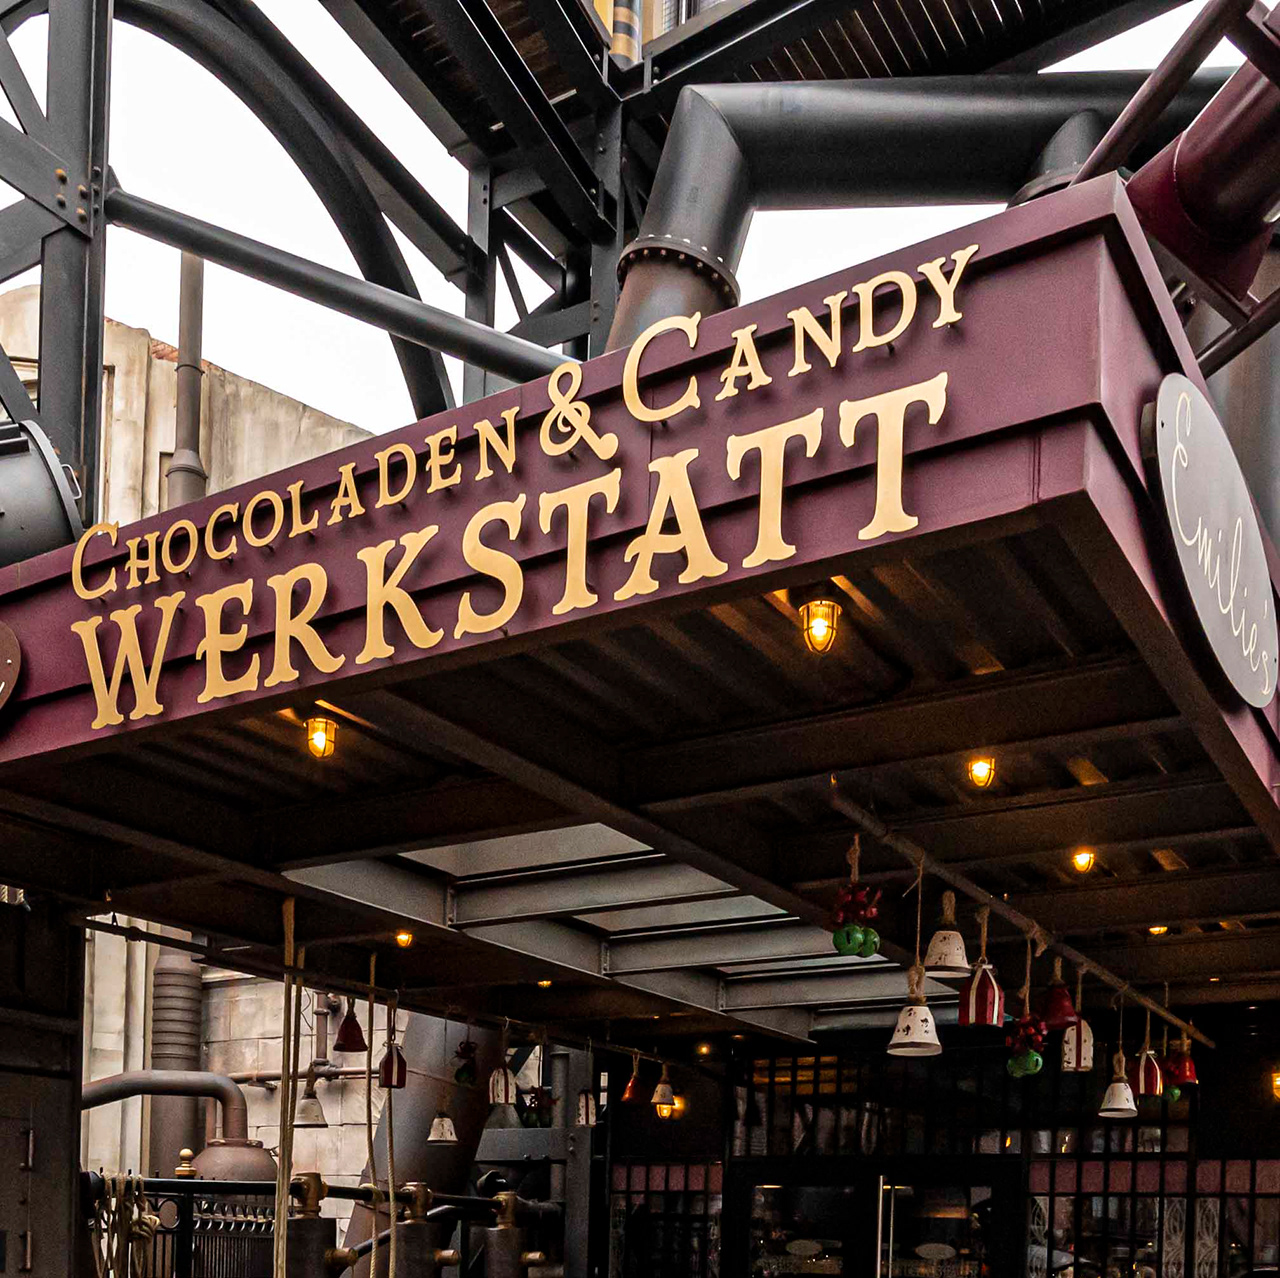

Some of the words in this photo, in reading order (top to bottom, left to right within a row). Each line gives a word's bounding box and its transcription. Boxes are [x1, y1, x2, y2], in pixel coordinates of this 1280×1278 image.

[70, 371, 949, 731] WERKSTATT
[71, 407, 521, 601] CHOCOLADEN
[539, 361, 619, 461] &
[621, 244, 981, 423] CANDY
[1171, 392, 1271, 695] Emilie's
